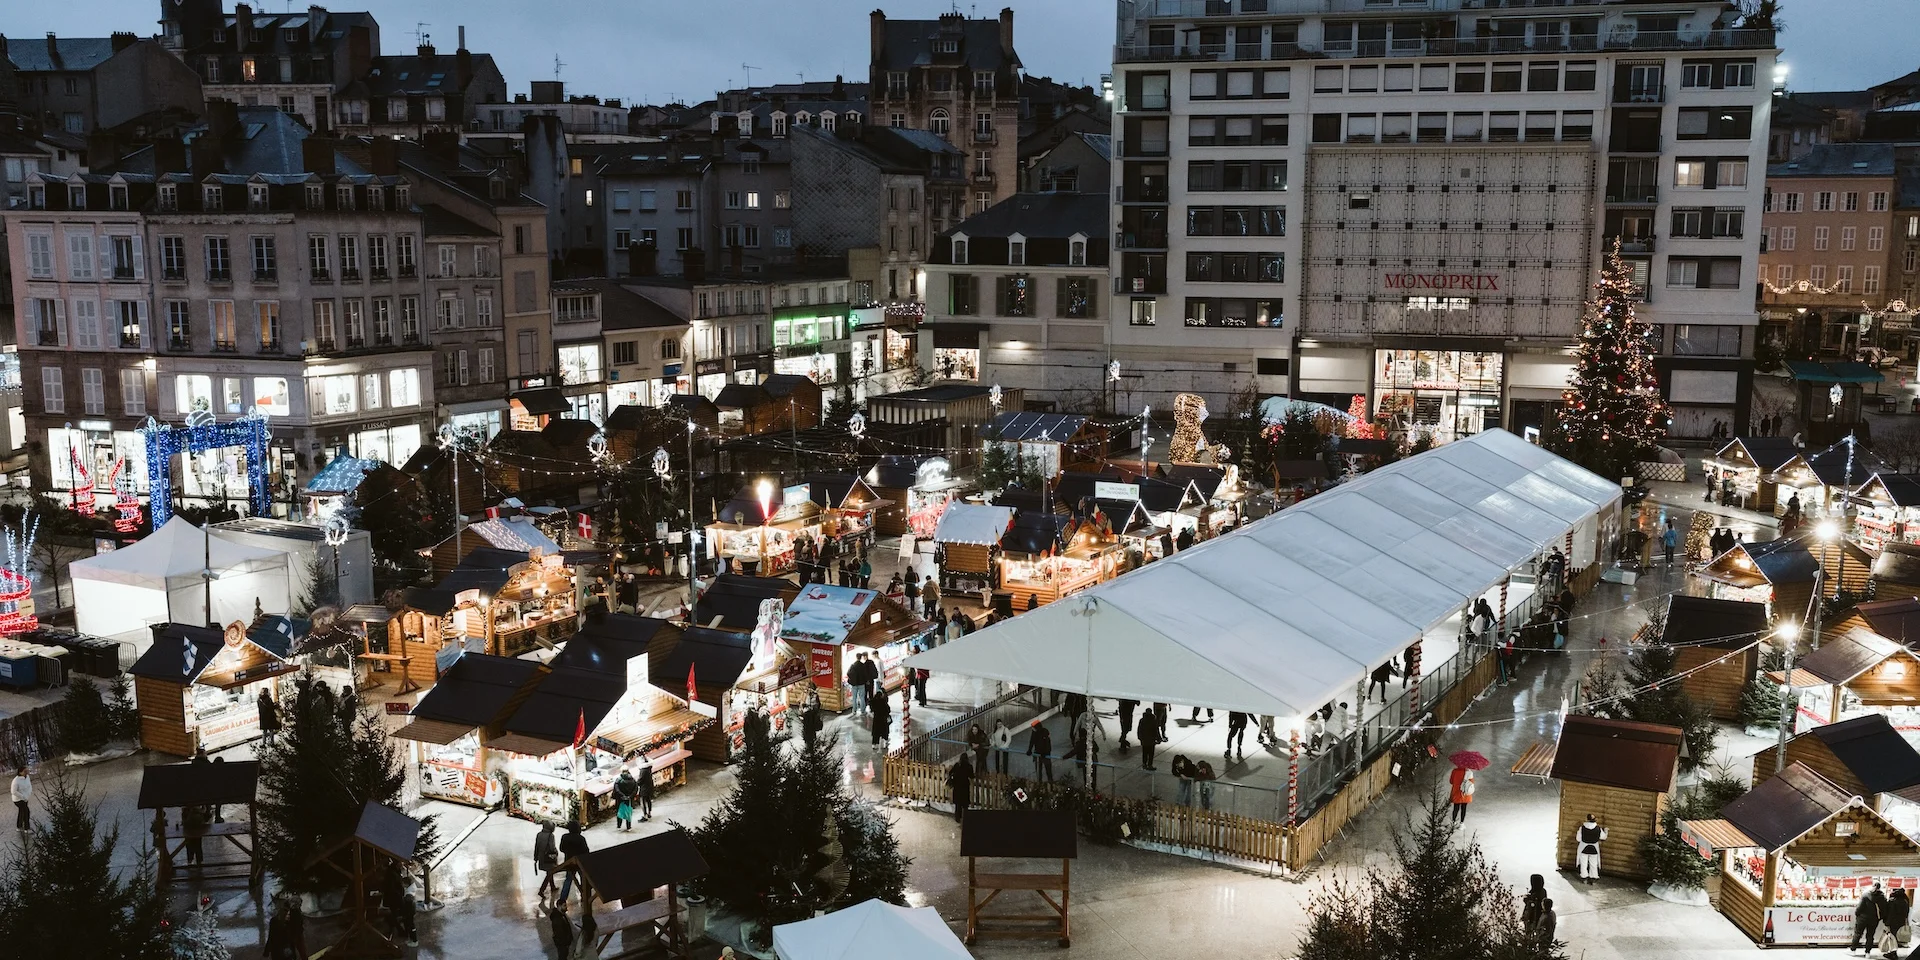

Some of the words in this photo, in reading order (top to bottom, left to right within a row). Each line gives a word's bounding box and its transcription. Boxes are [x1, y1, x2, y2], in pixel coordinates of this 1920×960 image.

[1384, 273, 1499, 290] MONOPRIX
[367, 421, 388, 429] LISSAC
[811, 648, 833, 656] CHURROS
[205, 724, 230, 736] SAUMON
[235, 720, 243, 728] LA
[1787, 911, 1804, 923] Le
[1807, 910, 1852, 923] Caveau
